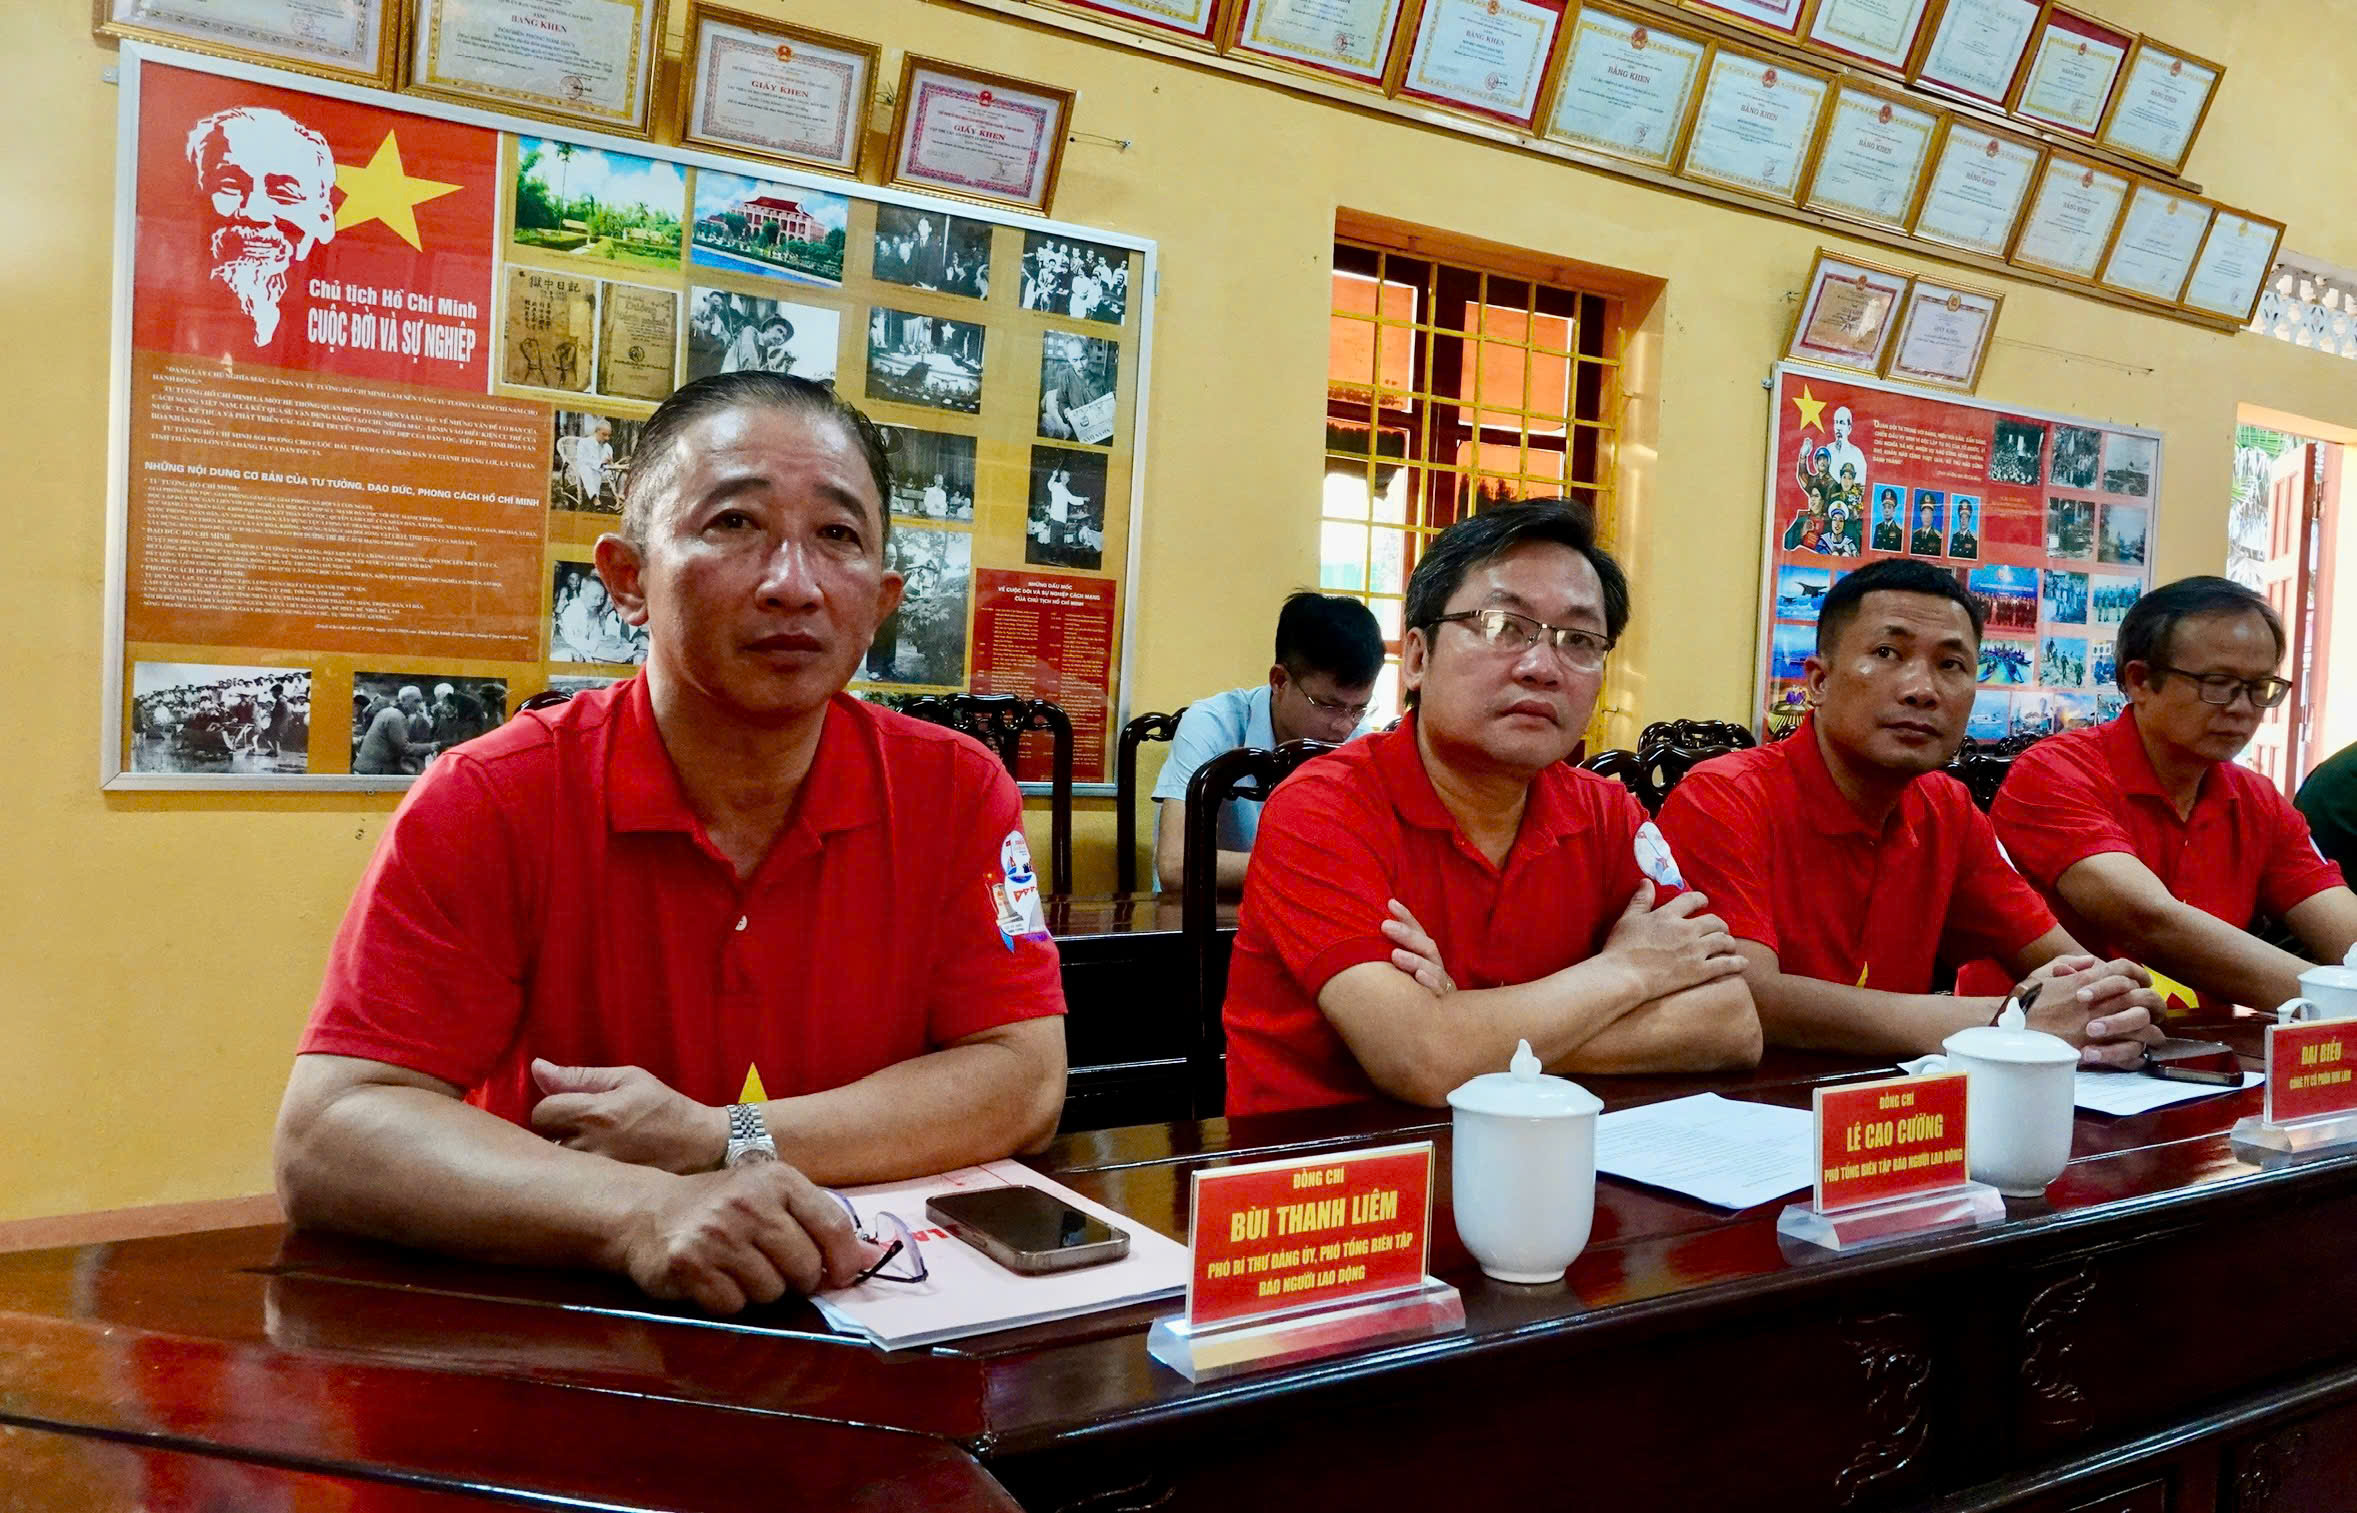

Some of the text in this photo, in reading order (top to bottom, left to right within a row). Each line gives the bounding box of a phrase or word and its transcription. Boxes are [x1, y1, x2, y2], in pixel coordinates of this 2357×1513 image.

[309, 278, 478, 319] Chủ tịch Hồ Chí Minh
[307, 303, 477, 369] CUỘC ĐỜI VÀ SỰ NGHIỆP
[144, 460, 184, 473] NHỮNG
[187, 464, 207, 477] NỘI
[209, 467, 240, 479] DUNG
[286, 472, 308, 485] CỦA
[367, 483, 389, 494] ĐẠO
[417, 488, 451, 498] PHONG
[453, 490, 480, 501] CÁCH
[497, 495, 513, 504] CHÍ
[515, 497, 540, 506] MINH
[1879, 1092, 1914, 1110] ĐỒNG CHÍ
[1846, 1112, 1944, 1152] LÊ CAO CƯỜNG
[1293, 1165, 1344, 1190] ĐỒNG CHÍ
[1824, 1167, 1840, 1183] PHÓ
[1841, 1162, 1859, 1180] TỔNG
[1878, 1159, 1892, 1175] TẬP
[1893, 1156, 1907, 1172] BÁO
[1908, 1152, 1930, 1169] NGƯỜI
[1931, 1151, 1943, 1165] LAO
[1944, 1148, 1963, 1164] ĐỘNG
[1230, 1188, 1398, 1242] BÙI THANH LIÊM
[1208, 1231, 1413, 1280] PHÓ BÍ THƯ ĐẢNG ỦY, PHÓ TỔNG BIÊN TẬP
[1258, 1265, 1366, 1297] BÁO NGƯỜI LAO ĐỘNG
